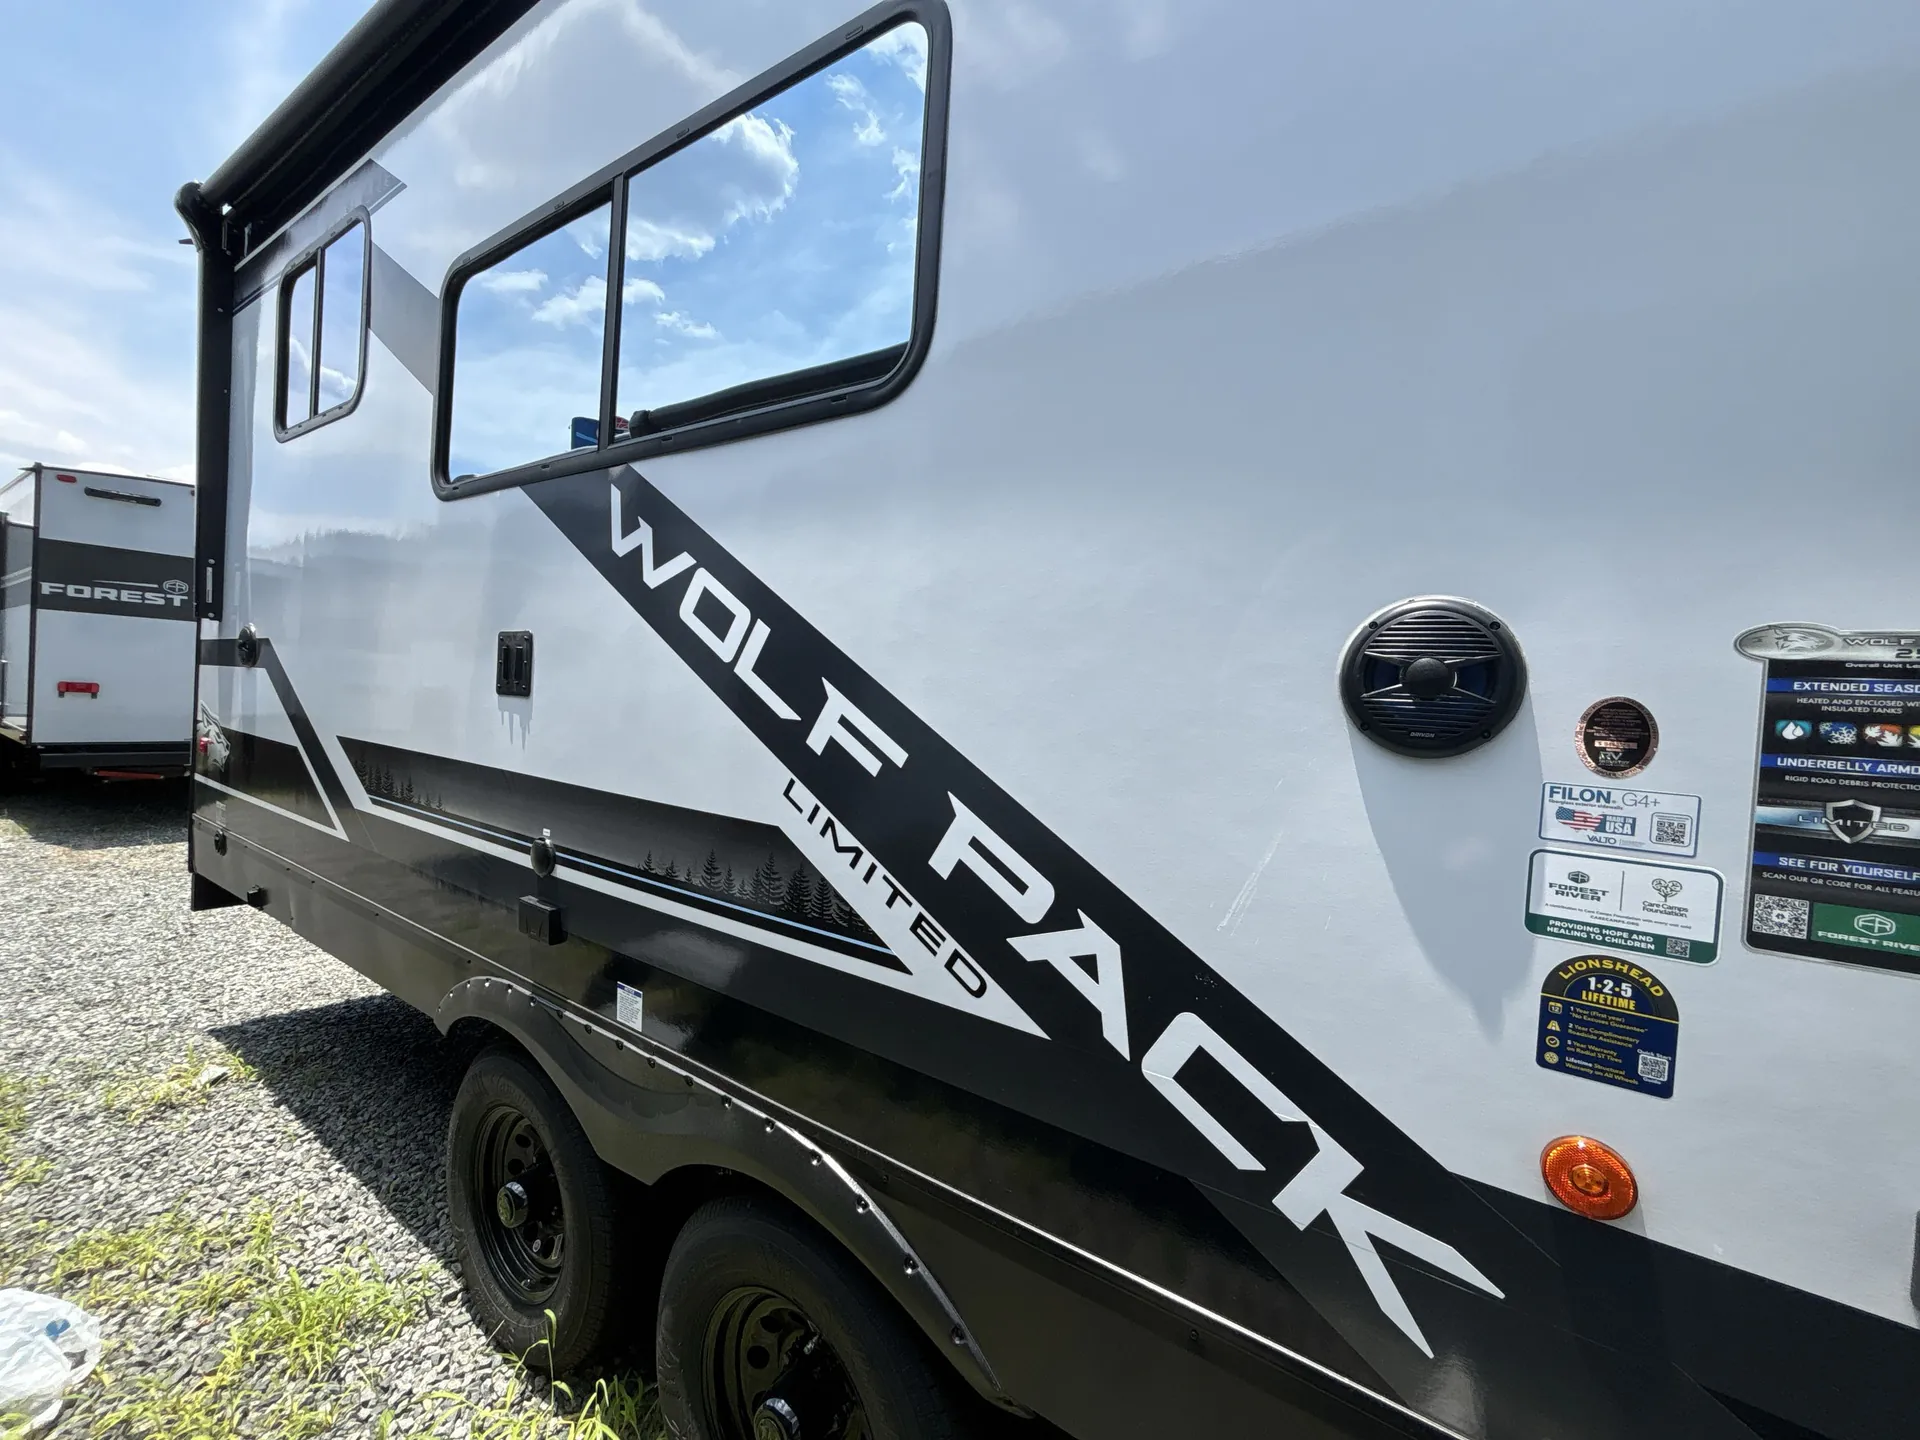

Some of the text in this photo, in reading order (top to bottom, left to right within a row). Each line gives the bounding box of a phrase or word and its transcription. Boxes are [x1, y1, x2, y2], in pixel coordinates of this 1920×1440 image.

[39, 581, 189, 607] FOREST
[1845, 638, 1916, 647] WOLF
[1895, 648, 1920, 659] 2
[1793, 681, 1870, 693] EXTENDED
[1796, 697, 1830, 705] HEATED
[1832, 698, 1853, 706] AND
[1855, 699, 1904, 707] ENCLOSED
[1821, 705, 1903, 715] INSULATED TANKS
[1777, 757, 1873, 772] UNDERBELLY
[1785, 775, 1809, 783] RIGID
[1811, 777, 1837, 785] ROAD
[1838, 778, 1870, 787] DEBRIS
[1621, 792, 1661, 808] G4+
[1606, 815, 1624, 823] MADE
[1798, 815, 1910, 833] LIMITED
[1605, 821, 1632, 835] USA
[1587, 835, 1617, 845] VALTO
[1778, 856, 1920, 881] SEE FOR YOURSELF
[782, 777, 988, 999] LIMITED
[1548, 882, 1610, 897] FOREST
[1762, 871, 1787, 881] SCAN
[1788, 874, 1808, 883] OUR
[1810, 877, 1824, 885] QR
[1826, 879, 1852, 889] CODE
[1854, 882, 1873, 891] FOR
[1874, 885, 1890, 894] ALL
[1555, 889, 1602, 902] RIVER
[1642, 900, 1689, 913] Care Camps
[1642, 906, 1688, 919] Foundation
[611, 482, 1505, 1359] WOLF PACK
[1546, 926, 1655, 950] HEALING TO CHILDREN
[1549, 919, 1654, 943] PROVIDING HOPE AND
[1817, 930, 1880, 945] FOREST
[1559, 958, 1664, 997] LIONSHEAD
[1581, 990, 1636, 1011] LIFETIME
[1574, 1024, 1589, 1032] Year
[1565, 1056, 1593, 1067] Lifetime
